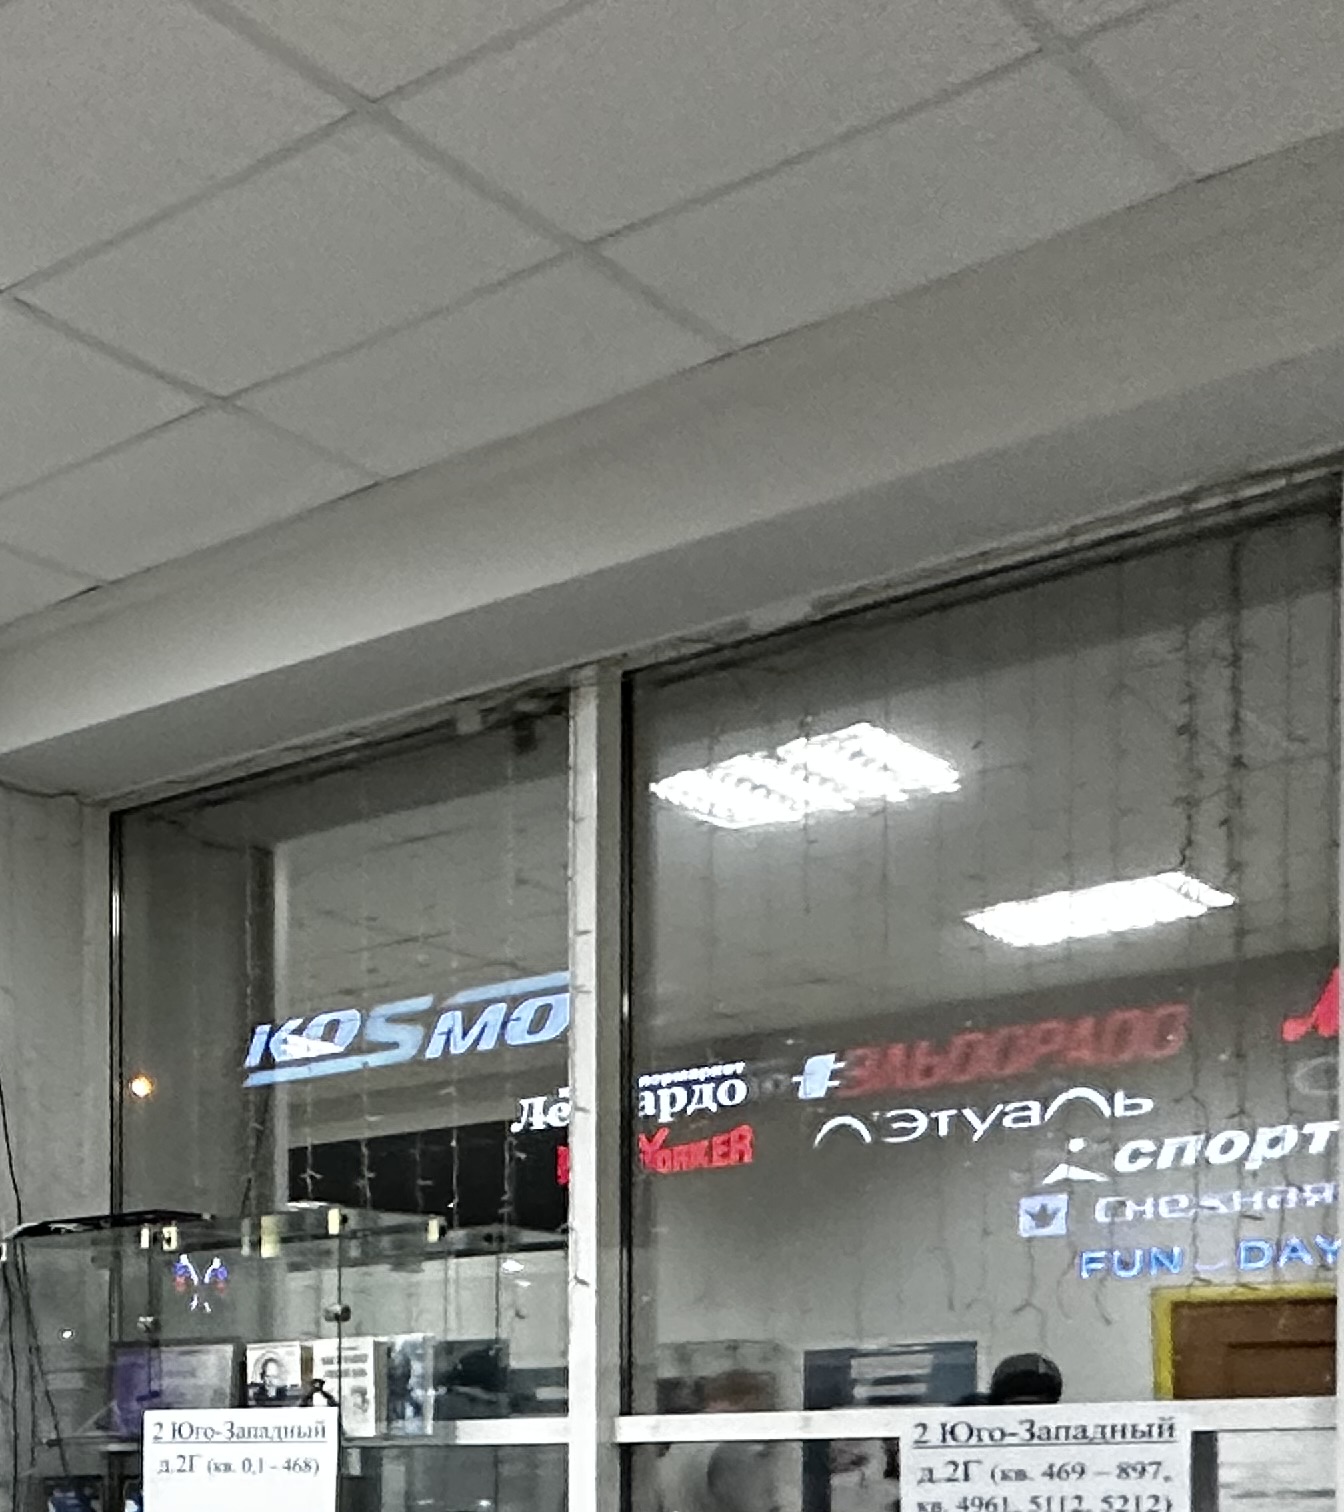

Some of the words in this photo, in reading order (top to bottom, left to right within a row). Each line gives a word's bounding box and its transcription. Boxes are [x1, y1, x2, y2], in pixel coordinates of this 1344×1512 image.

[1079, 1246, 1183, 1280] FUN
[1237, 1234, 1341, 1271] DAY
[152, 1422, 164, 1441] 2
[171, 1420, 326, 1442] Юго-Западный
[913, 1422, 929, 1444] 2
[940, 1417, 1176, 1444] Юго-Западный
[917, 1460, 983, 1484] д.2Г
[1040, 1462, 1087, 1481] 469
